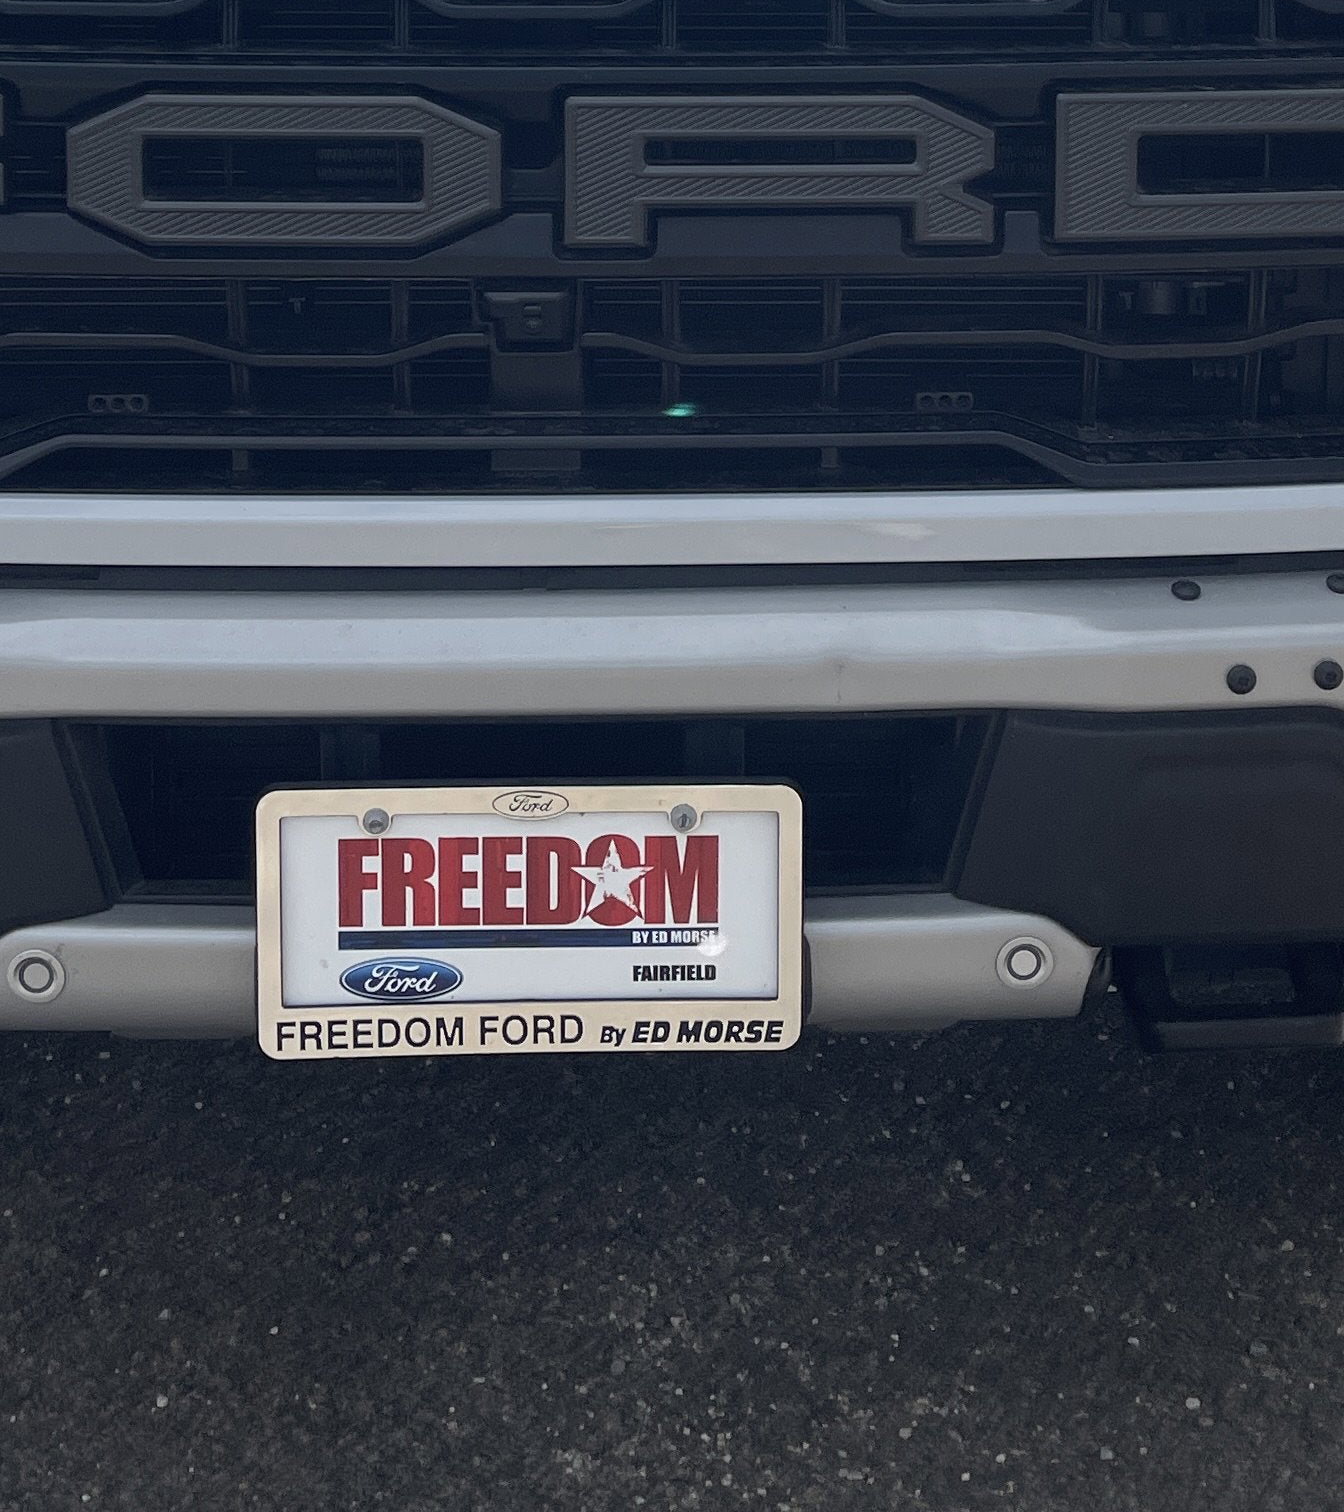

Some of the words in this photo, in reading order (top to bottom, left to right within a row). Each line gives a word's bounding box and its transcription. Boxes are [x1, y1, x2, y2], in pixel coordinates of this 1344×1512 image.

[508, 794, 554, 812] Ford
[338, 833, 719, 928] FREEDOM
[632, 930, 649, 944] BY
[651, 930, 668, 944] ED
[364, 963, 438, 993] Ford
[632, 964, 716, 982] FAIRFIELD
[276, 1016, 464, 1052] FREEDOM
[479, 1014, 584, 1046] FORD
[599, 1025, 626, 1047] By
[631, 1020, 671, 1044] ED
[676, 1020, 784, 1044] MORSE
